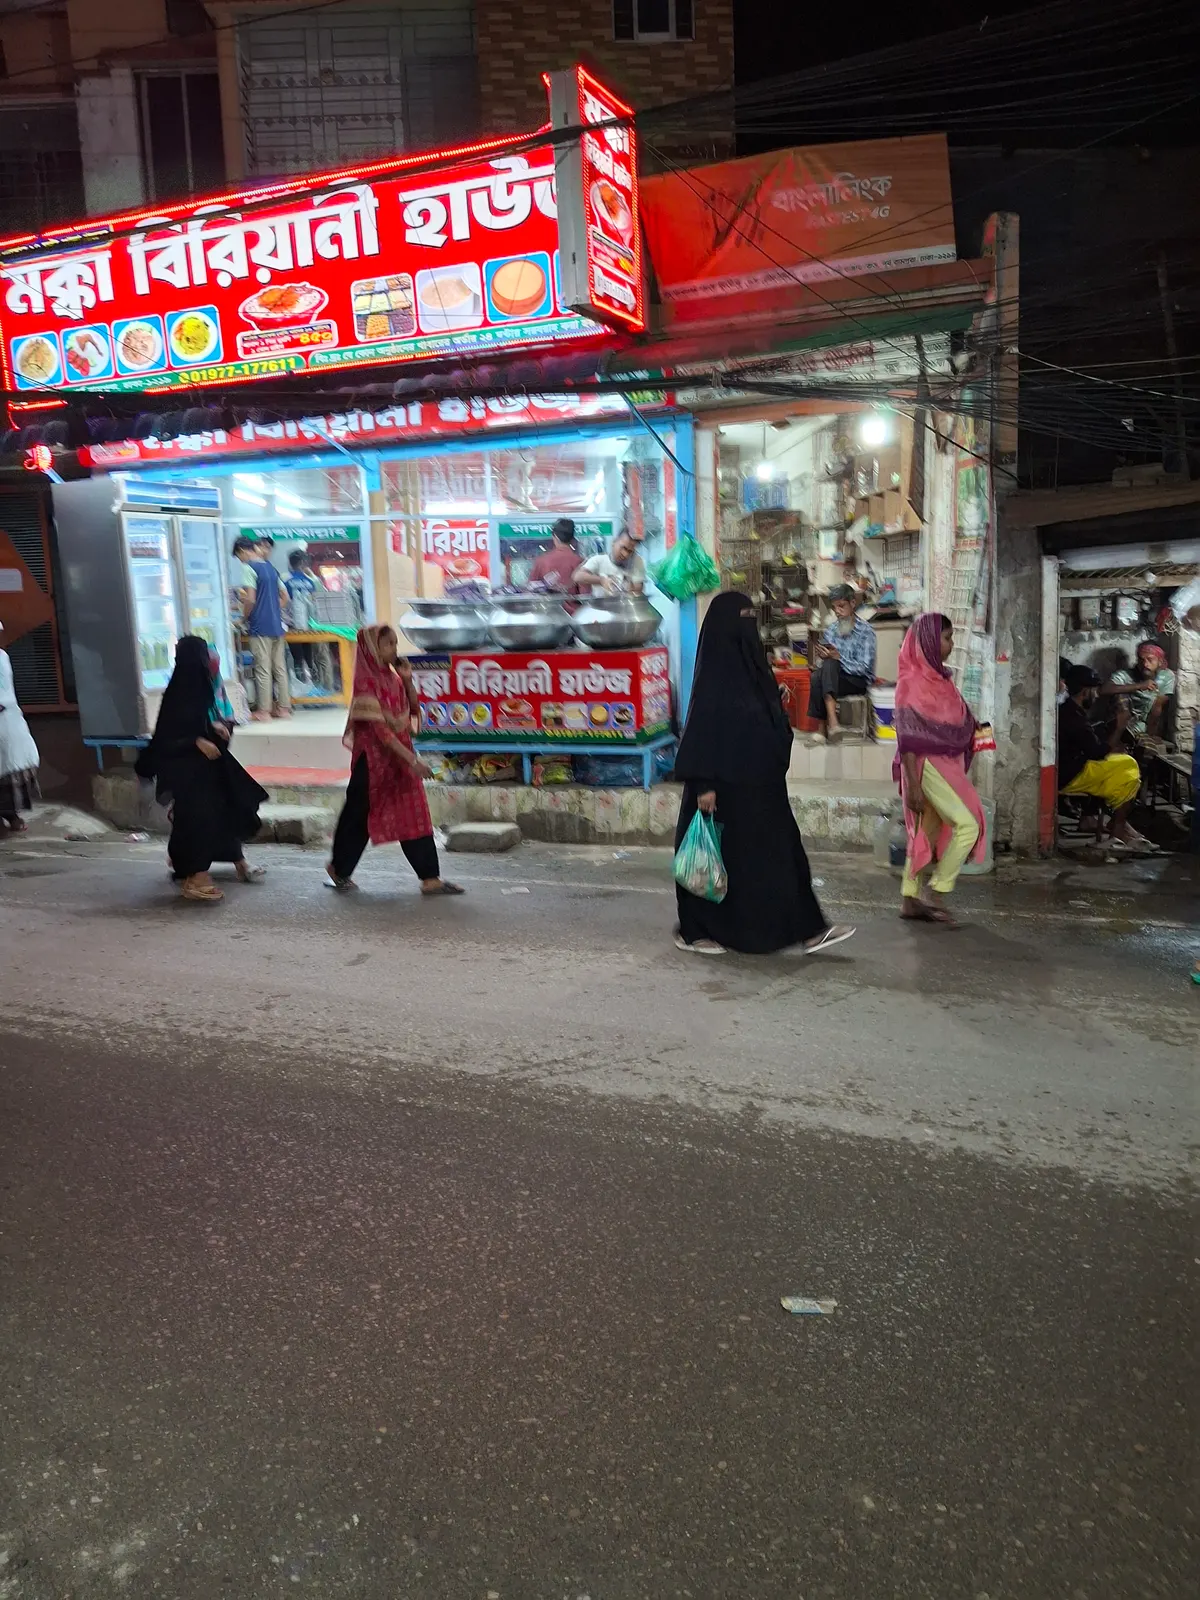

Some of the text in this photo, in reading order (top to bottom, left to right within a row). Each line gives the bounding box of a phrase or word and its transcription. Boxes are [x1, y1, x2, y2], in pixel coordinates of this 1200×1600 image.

[771, 172, 893, 212] বাংলালিংক
[870, 204, 891, 220] 4G
[1, 156, 558, 320] মক্কা বিরিয়ানী হাউ
[190, 357, 297, 383] 01977-177611
[455, 659, 554, 698] বিরিয়ানী
[557, 661, 633, 697] হাউজ
